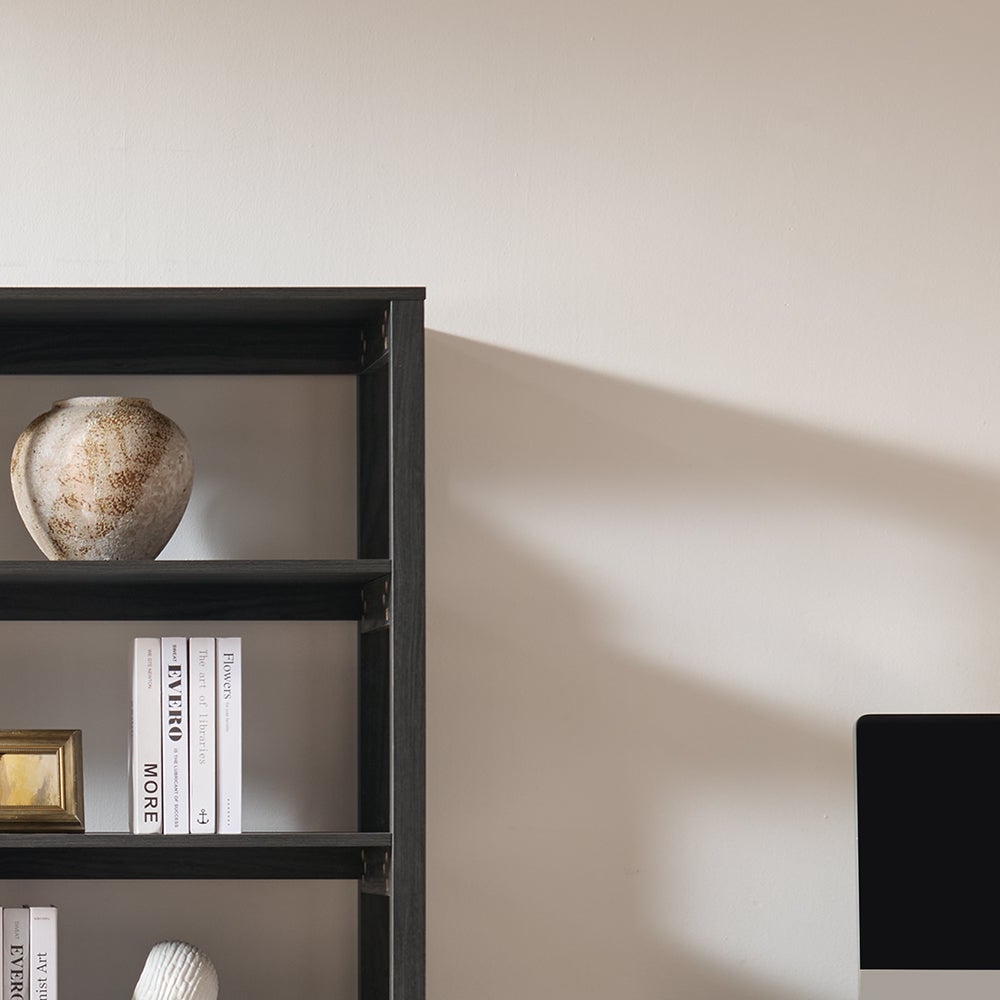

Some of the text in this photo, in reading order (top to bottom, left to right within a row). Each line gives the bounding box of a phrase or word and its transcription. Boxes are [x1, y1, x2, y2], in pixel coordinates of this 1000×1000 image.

[168, 664, 183, 742] EVERO
[223, 653, 235, 700] Flowers
[199, 649, 208, 765] The art of libraries
[144, 763, 158, 823] MORE
[36, 952, 48, 974] Art
